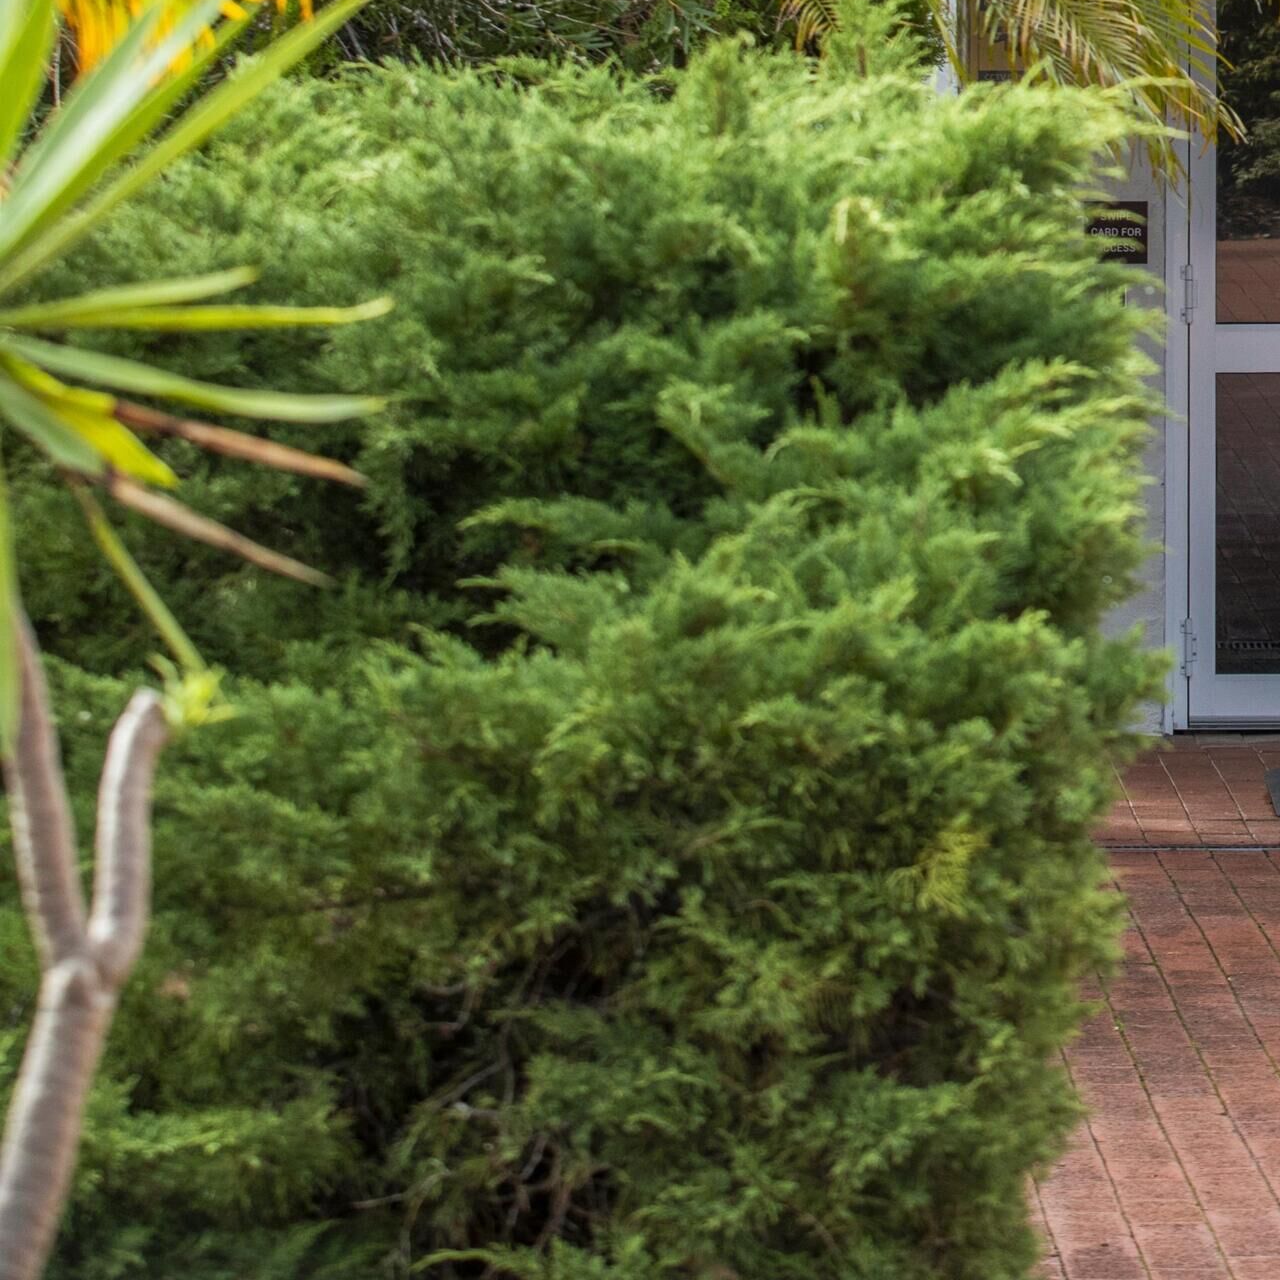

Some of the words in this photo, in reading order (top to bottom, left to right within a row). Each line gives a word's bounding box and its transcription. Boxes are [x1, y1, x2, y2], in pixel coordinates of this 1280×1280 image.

[1090, 227, 1119, 237] CARD
[1121, 227, 1142, 237] FOR
[1097, 242, 1136, 253] CCESS
